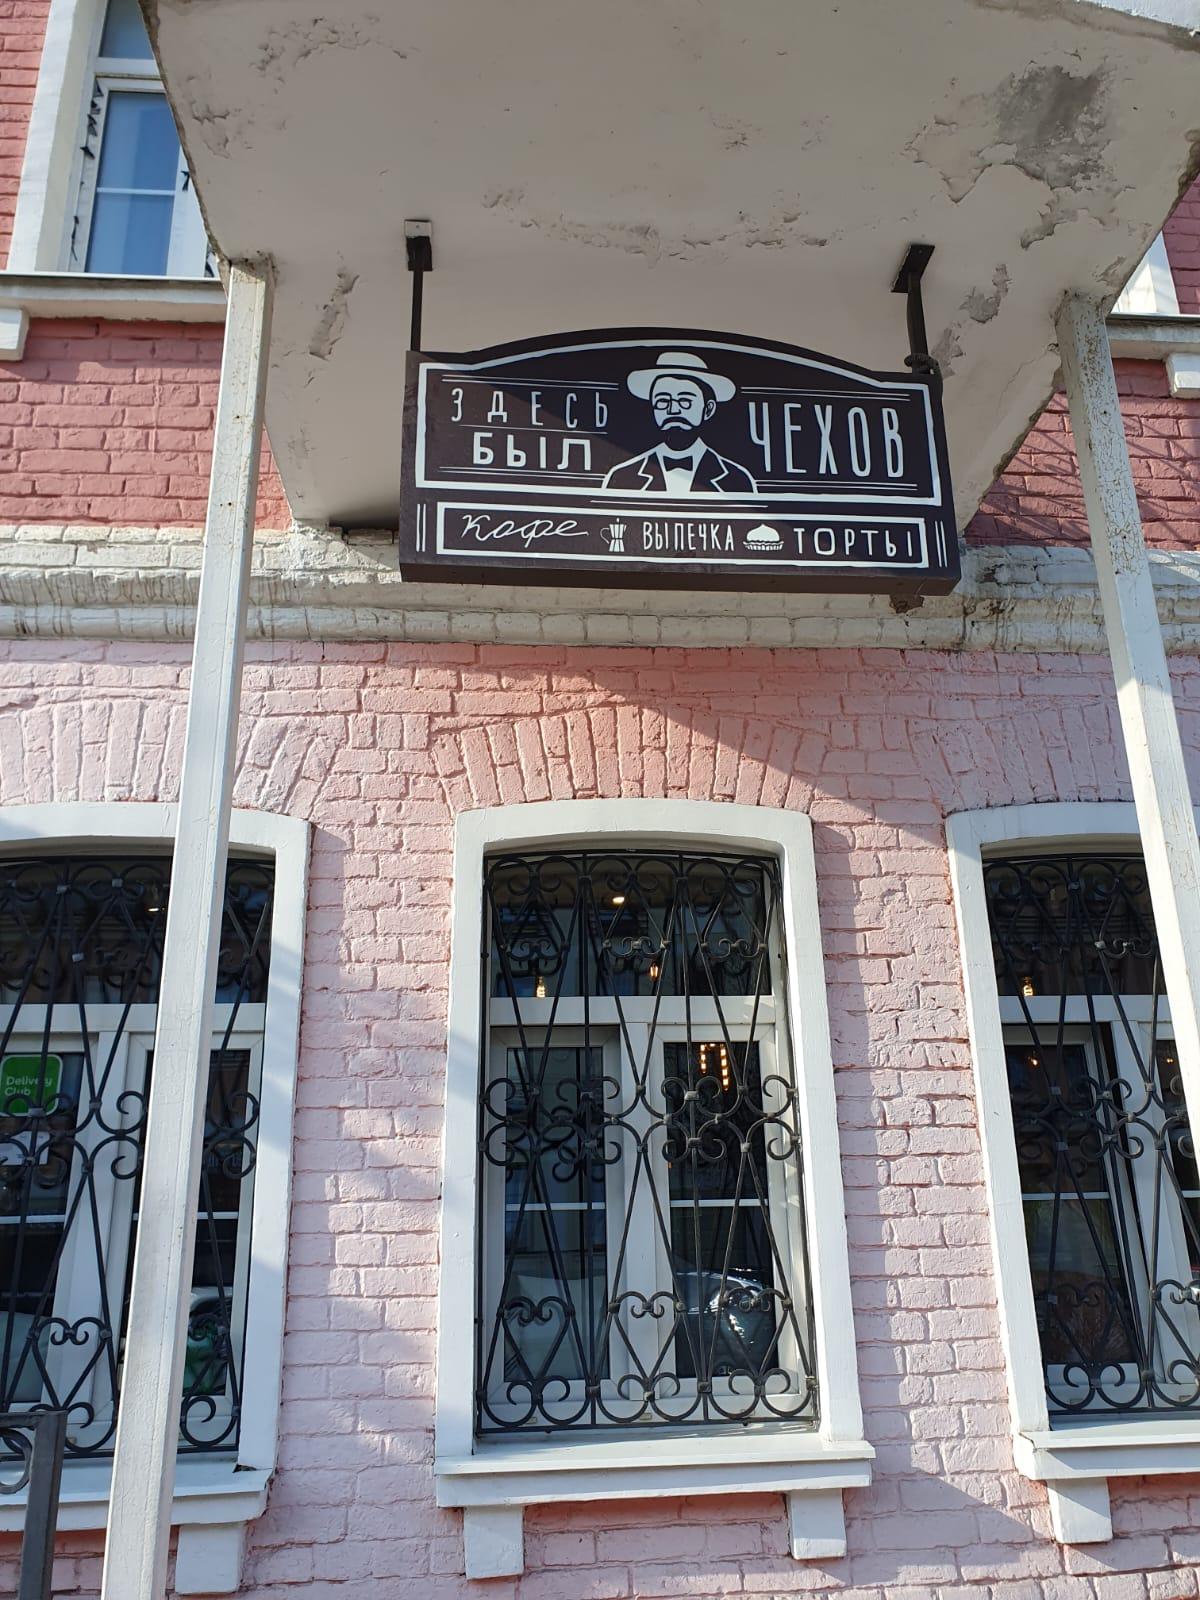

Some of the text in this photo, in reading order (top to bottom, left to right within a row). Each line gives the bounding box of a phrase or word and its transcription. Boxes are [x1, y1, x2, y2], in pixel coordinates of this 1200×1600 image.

[451, 387, 609, 428] ЗДЕСЬ
[472, 431, 592, 471] БЫЛ
[748, 401, 905, 478] ЧЕХОВ
[461, 512, 913, 557] Кофе ВЫПЕЧКА ТОРТЫ
